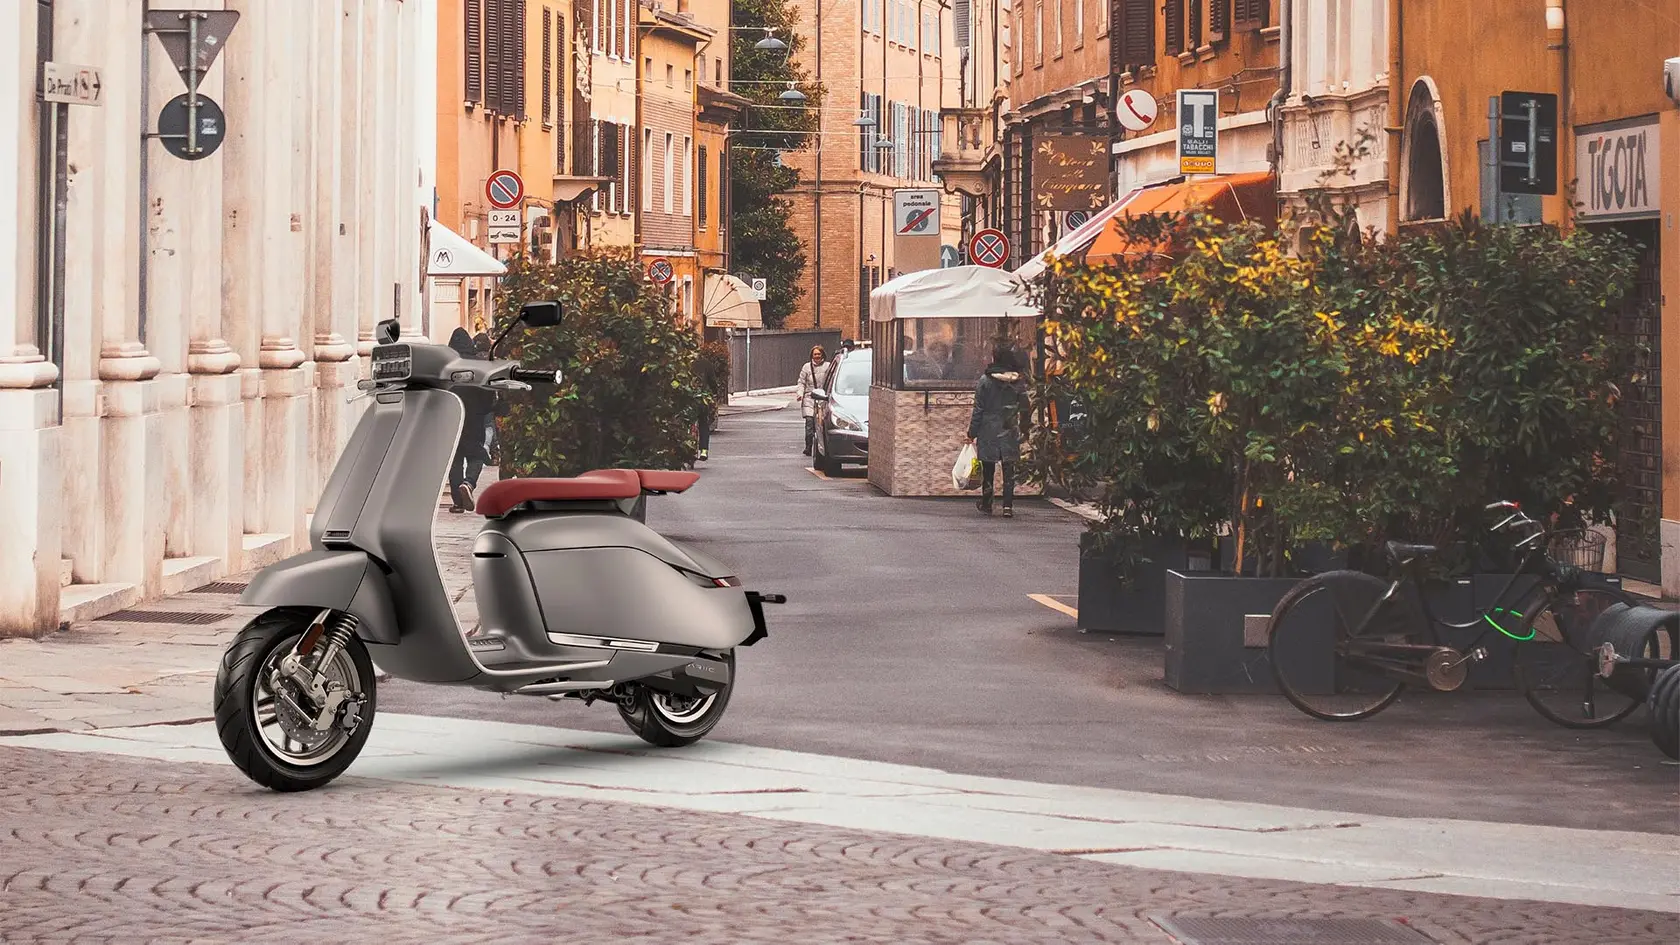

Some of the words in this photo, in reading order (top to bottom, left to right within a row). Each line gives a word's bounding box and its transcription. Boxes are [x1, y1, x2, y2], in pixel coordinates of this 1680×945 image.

[1183, 94, 1214, 138] T
[492, 214, 498, 222] 0
[505, 214, 516, 222] 24
